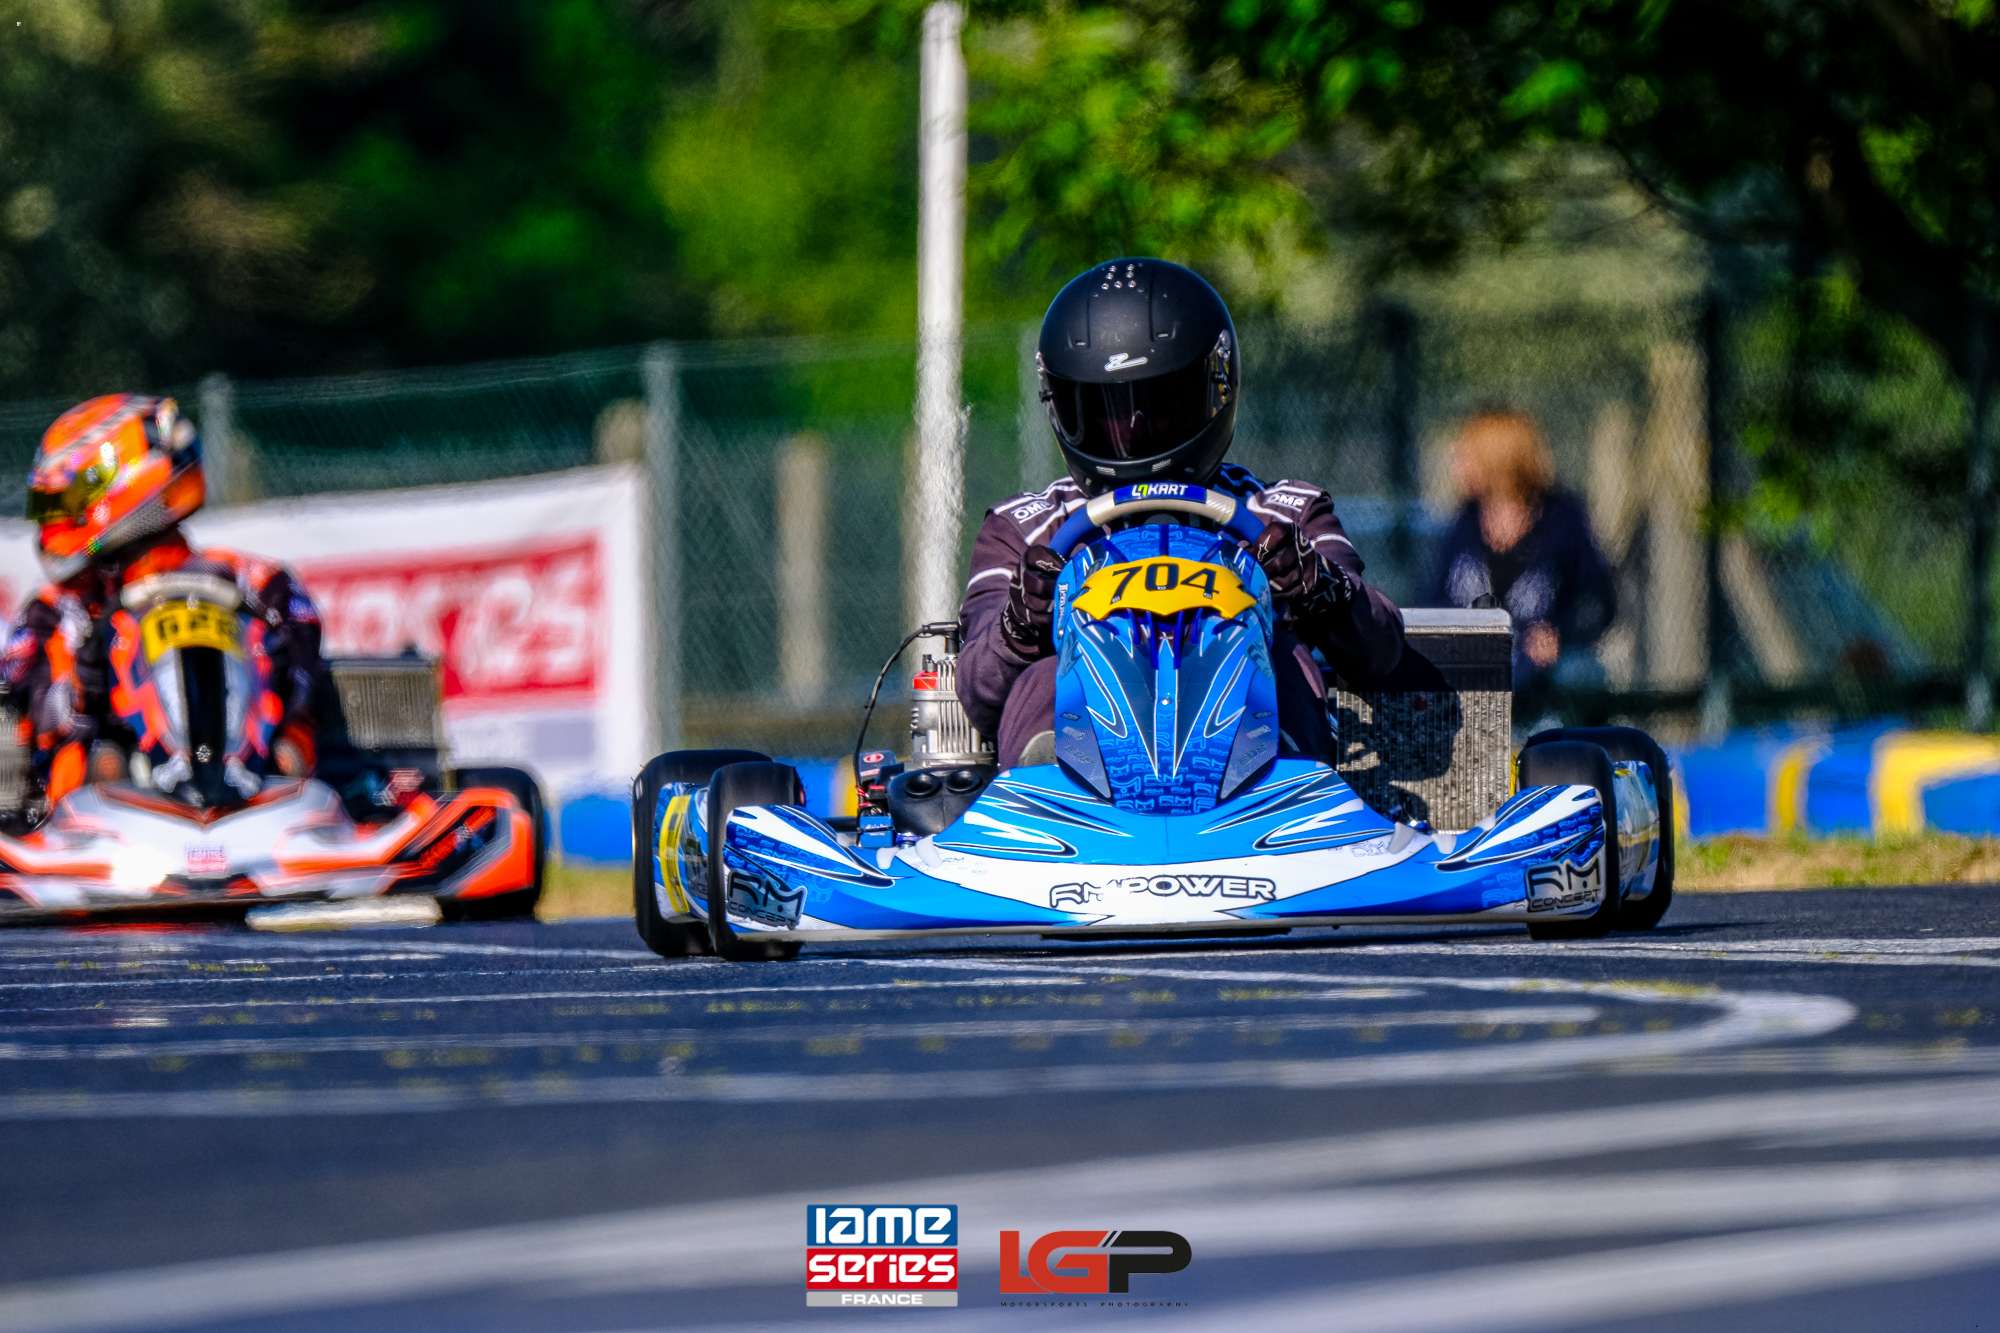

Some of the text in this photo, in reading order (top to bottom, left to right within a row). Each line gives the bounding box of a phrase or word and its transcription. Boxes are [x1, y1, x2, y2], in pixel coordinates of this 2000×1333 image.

[1266, 494, 1305, 507] OMP
[1109, 562, 1220, 605] 704
[1527, 856, 1601, 897] RM
